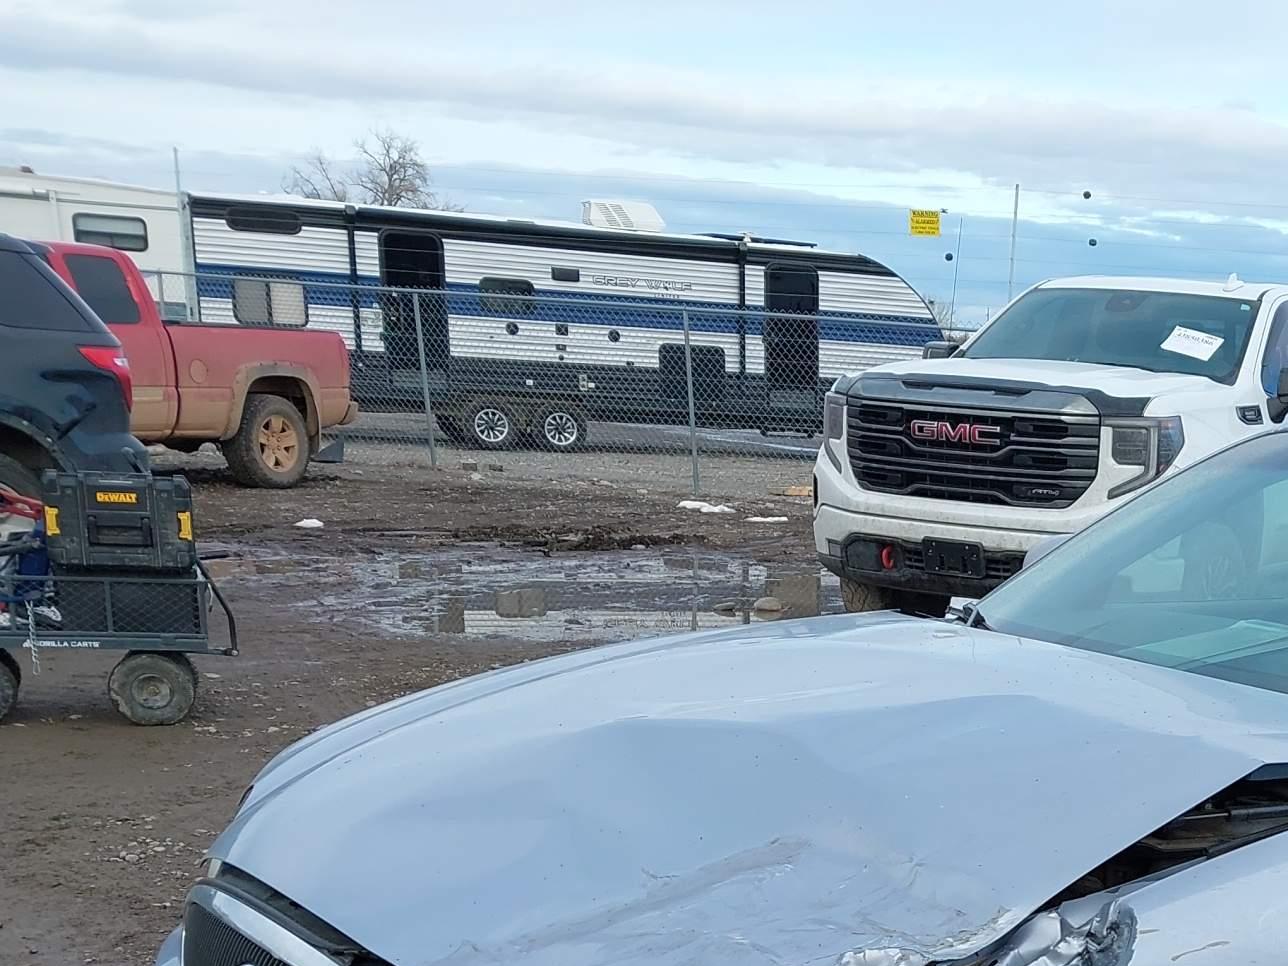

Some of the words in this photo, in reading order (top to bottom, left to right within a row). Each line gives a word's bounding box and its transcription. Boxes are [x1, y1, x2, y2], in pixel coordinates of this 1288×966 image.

[592, 275, 640, 288] GREY
[911, 419, 1001, 446] GMC
[70, 640, 100, 648] CARTS
